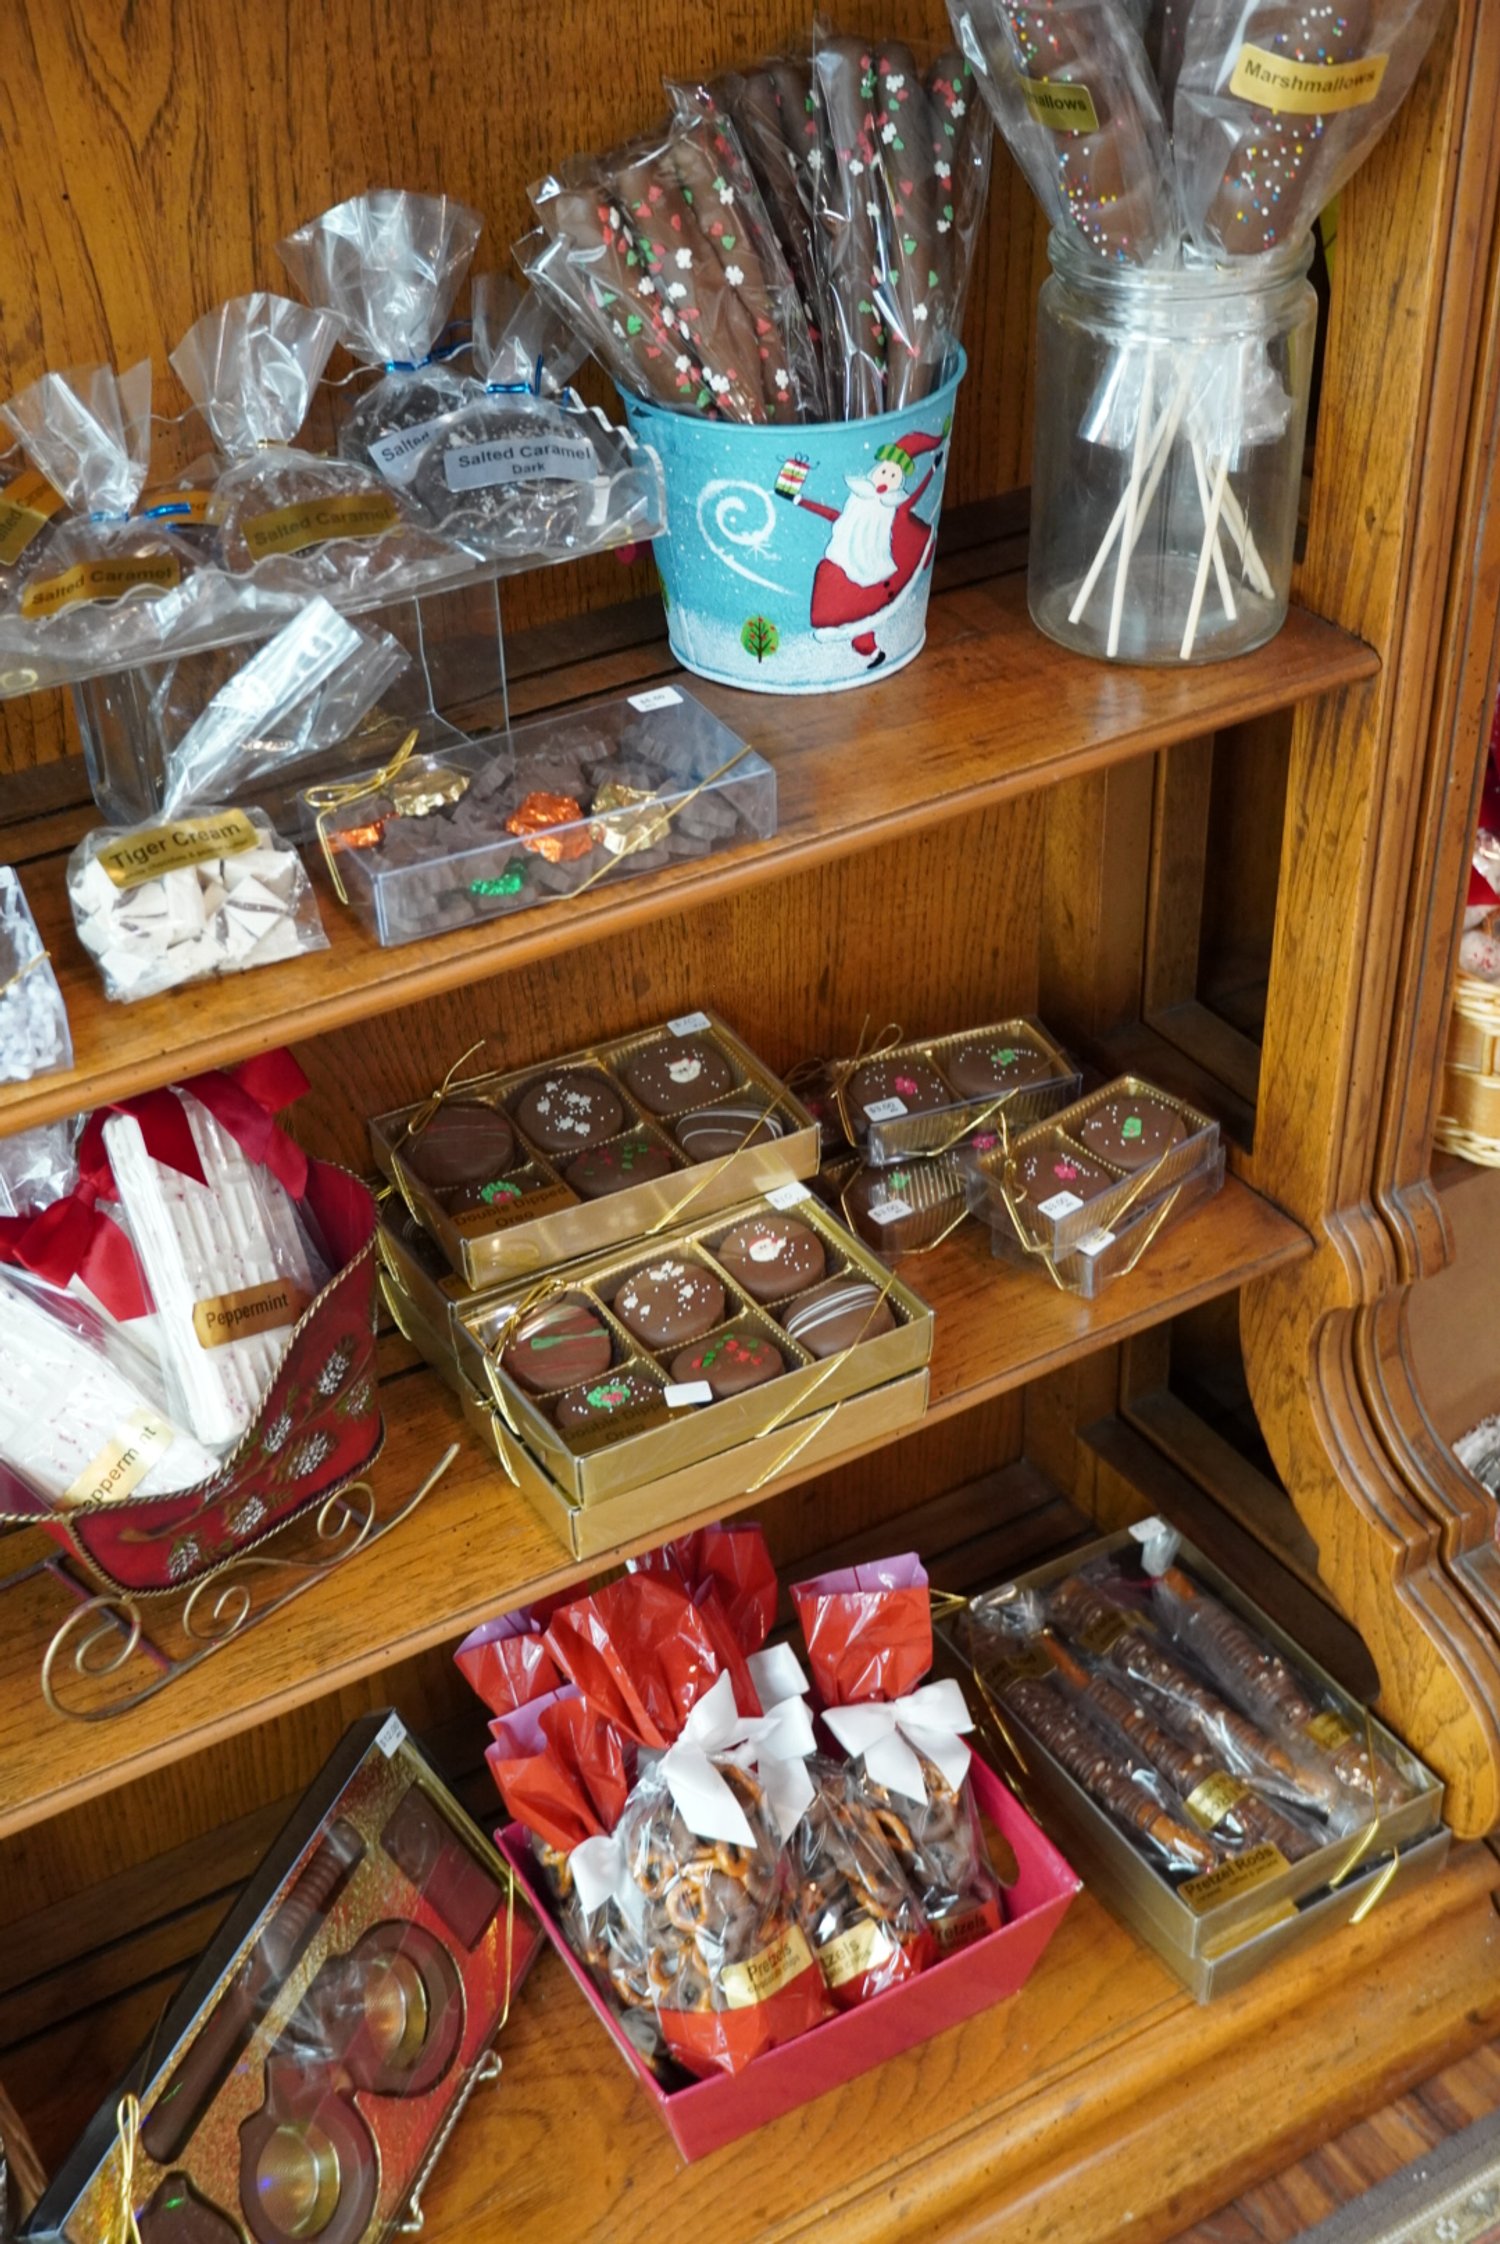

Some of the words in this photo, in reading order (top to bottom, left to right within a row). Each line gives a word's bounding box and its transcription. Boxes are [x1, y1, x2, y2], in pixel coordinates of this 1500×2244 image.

[1244, 59, 1375, 94] Marshmallows
[459, 447, 515, 469] Salted
[520, 443, 592, 461] Caramel
[511, 462, 546, 476] Dark
[252, 515, 312, 547] Salted
[315, 508, 392, 527] Caramel
[32, 575, 86, 606] Salted
[90, 566, 173, 583] Caramel
[109, 839, 167, 870] Tiger
[172, 821, 242, 847] Cream
[453, 1203, 511, 1227] Double
[513, 1184, 568, 1209] Dipped
[495, 1210, 535, 1228] Oreo
[206, 1292, 289, 1329] Peppermint
[562, 1414, 621, 1441] Double
[605, 1423, 646, 1442] Oreo
[1184, 1863, 1236, 1898] Pretzel
[1234, 1847, 1275, 1872] Rods
[746, 1942, 792, 1982] Pretzels
